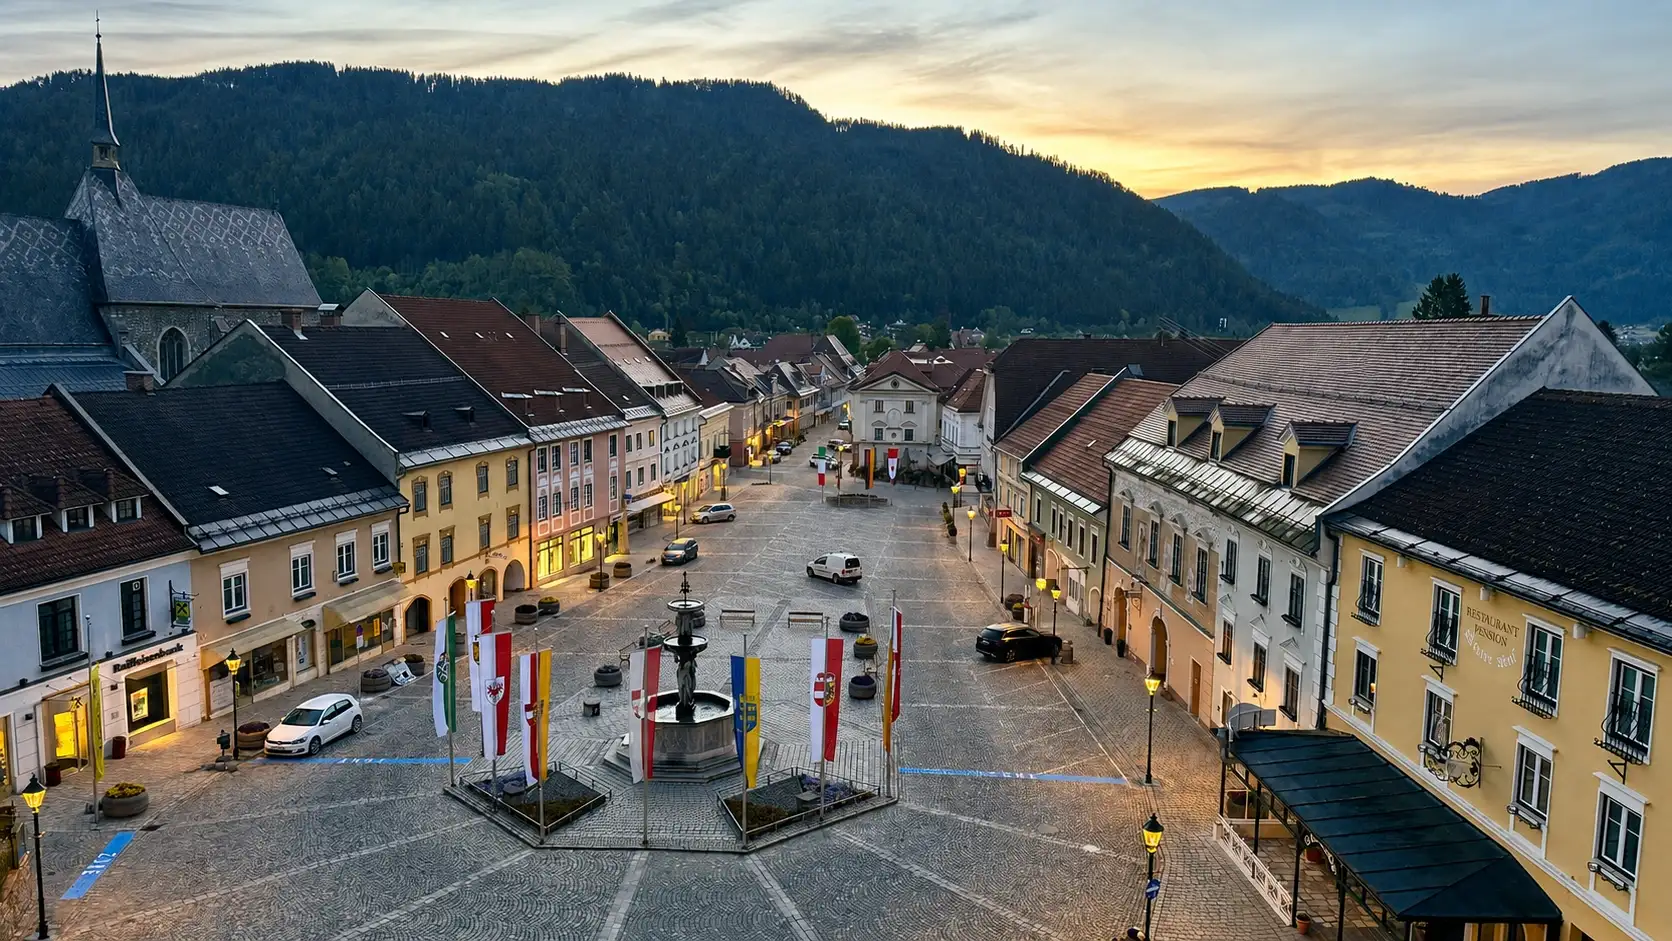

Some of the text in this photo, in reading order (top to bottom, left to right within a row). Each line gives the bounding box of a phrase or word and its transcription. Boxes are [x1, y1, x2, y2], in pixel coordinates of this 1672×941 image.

[1466, 605, 1520, 638] RESTAURANT
[1474, 623, 1508, 647] PENSION
[112, 642, 184, 674] Raiffeisenbank
